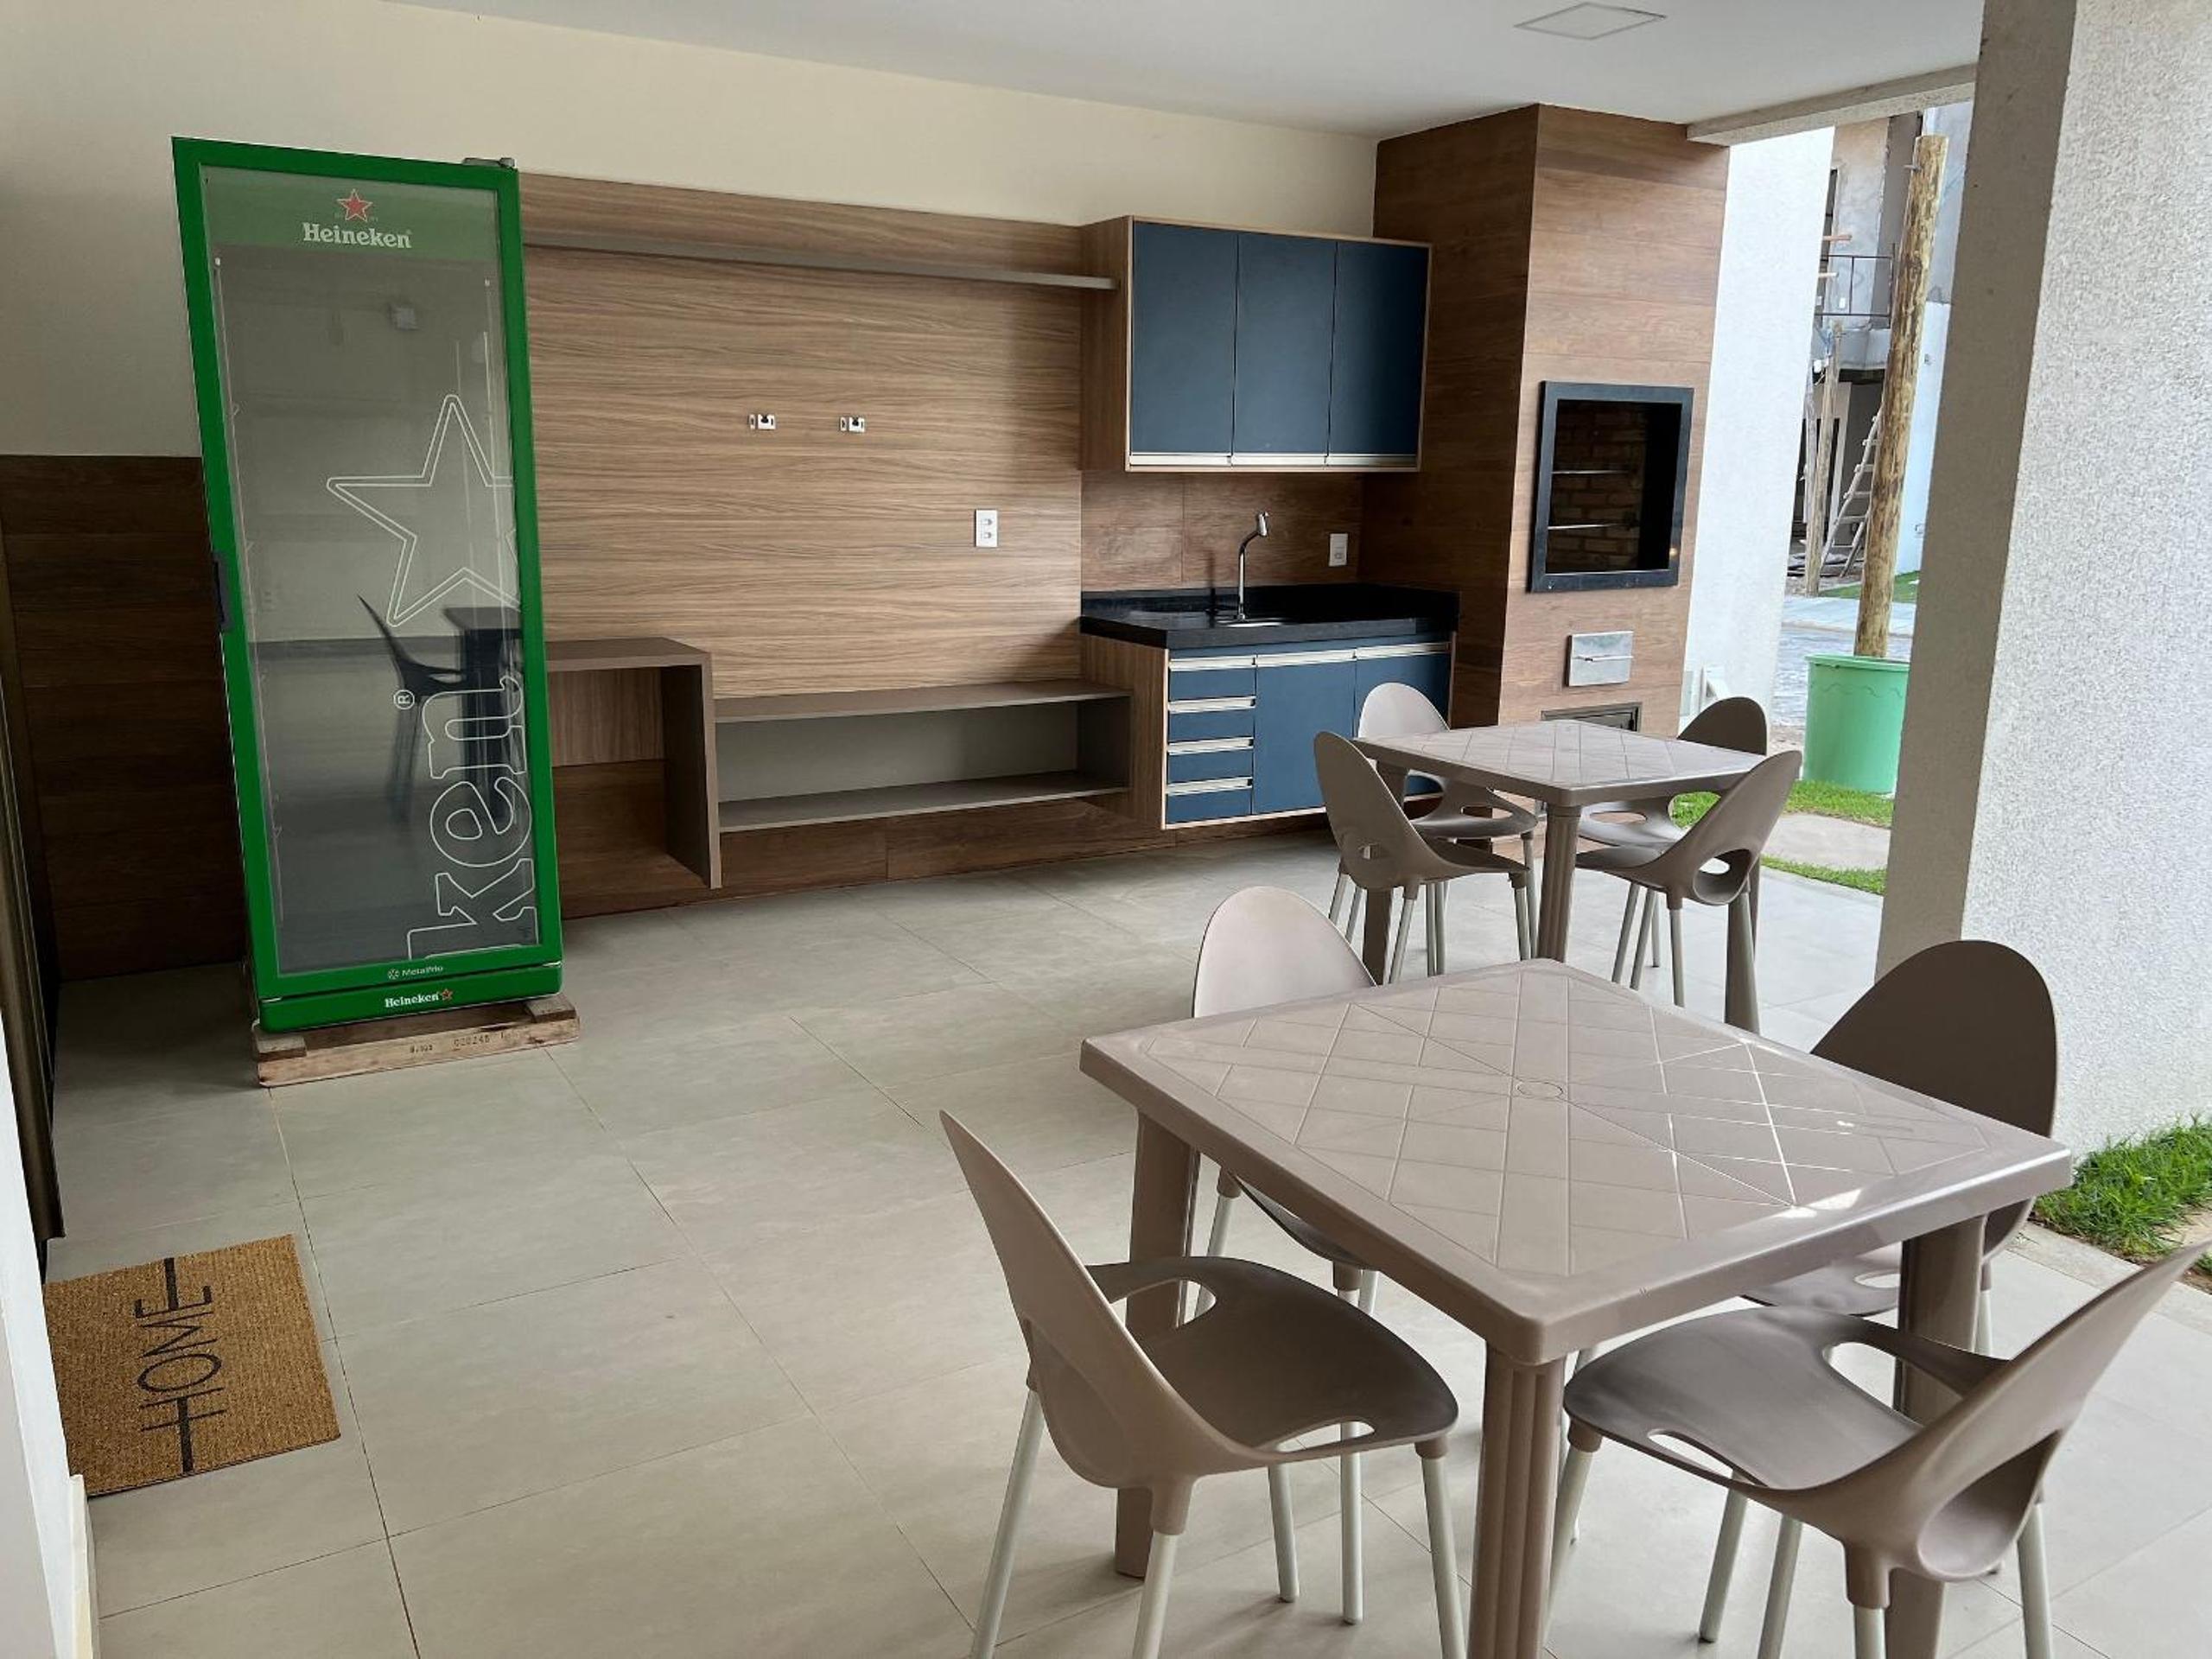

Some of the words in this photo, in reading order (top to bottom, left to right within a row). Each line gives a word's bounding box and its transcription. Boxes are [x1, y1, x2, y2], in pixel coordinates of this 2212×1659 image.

[302, 222, 413, 249] Heineken
[385, 991, 439, 1008] Heineken
[134, 1257, 228, 1474] HOME
